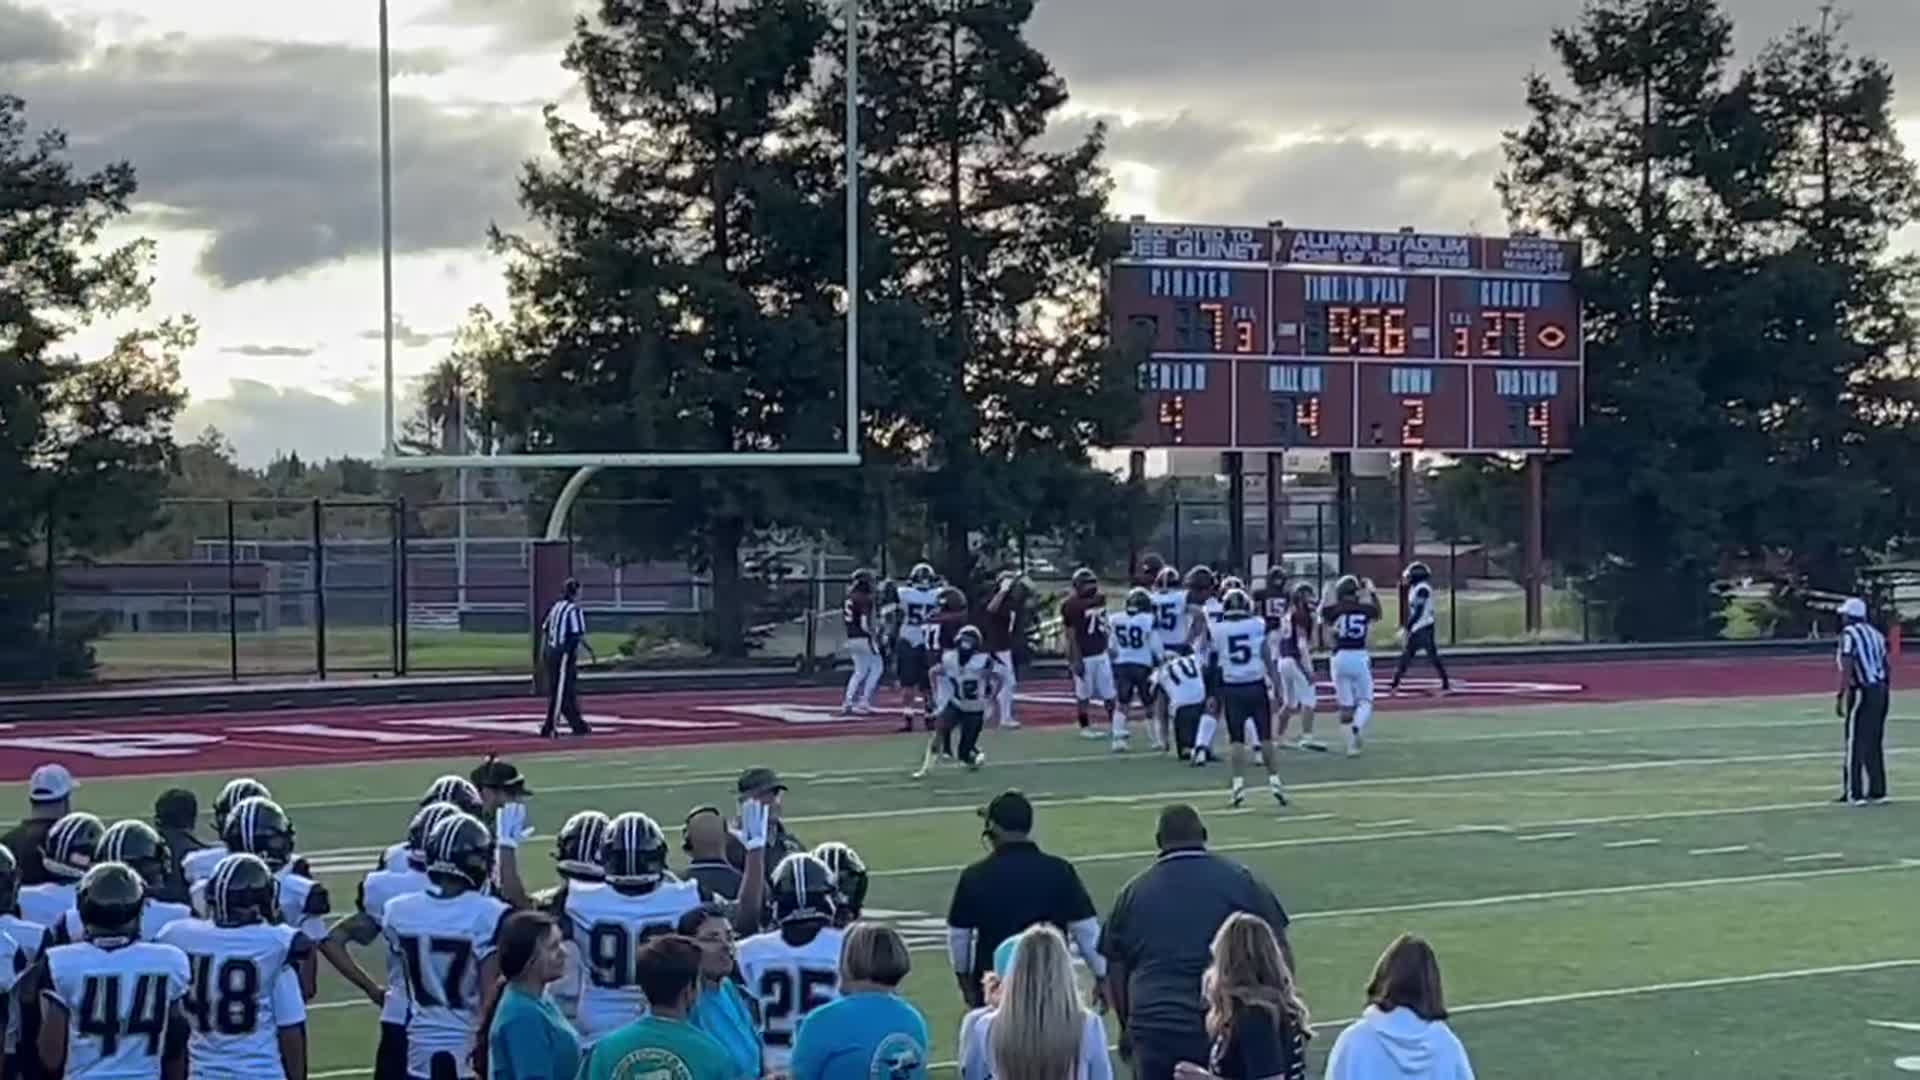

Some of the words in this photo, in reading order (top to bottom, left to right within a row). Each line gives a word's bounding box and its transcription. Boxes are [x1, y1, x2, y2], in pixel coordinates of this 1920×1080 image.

[1293, 232, 1373, 250] ALUMNI
[1378, 235, 1469, 254] STADIUM
[1200, 303, 1223, 349] 7
[1236, 321, 1251, 352] 3
[1454, 327, 1469, 357] 3
[1481, 311, 1525, 357] 27
[1160, 395, 1184, 443] 4
[1296, 397, 1319, 437] 4
[1402, 399, 1424, 445] 2
[1527, 400, 1549, 446] 4
[1115, 625, 1144, 649] 58
[1333, 613, 1367, 638] 45
[1228, 634, 1251, 665] 5
[400, 935, 472, 1009] 17
[79, 974, 169, 1057] 44
[757, 966, 840, 1047] 25
